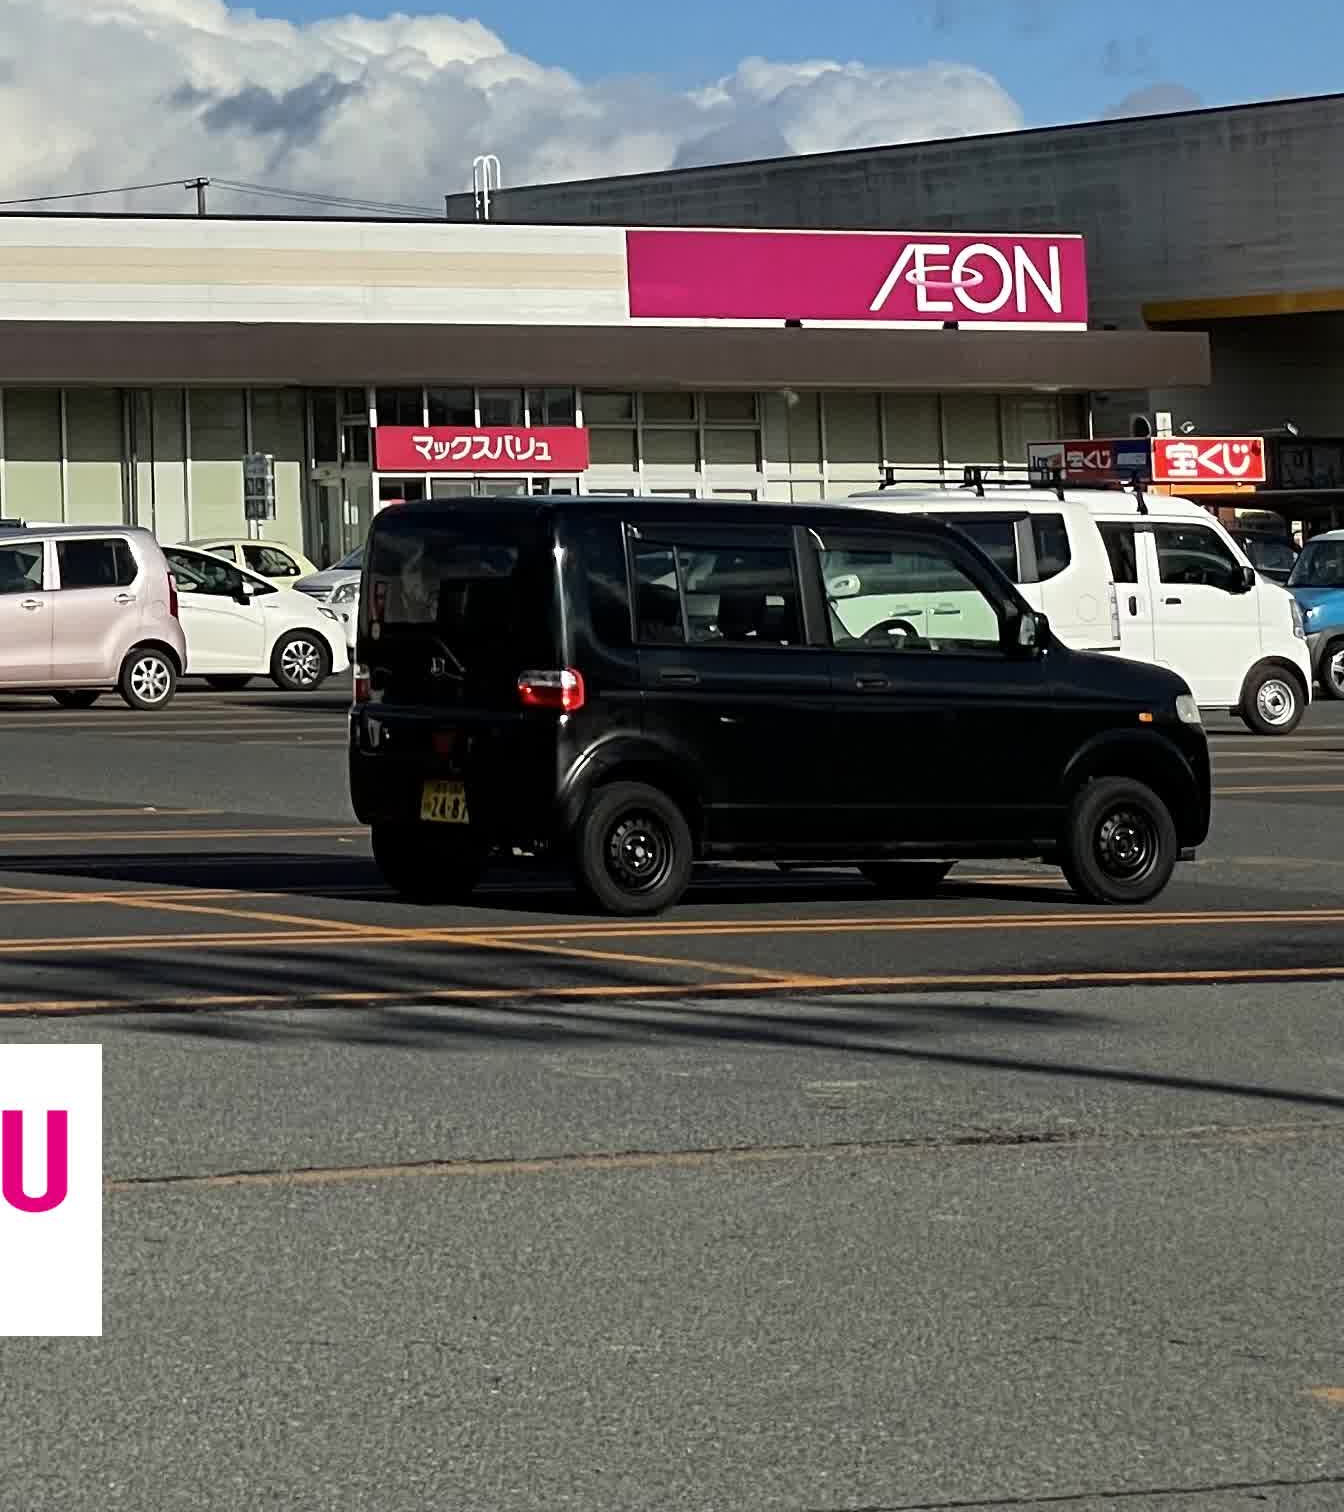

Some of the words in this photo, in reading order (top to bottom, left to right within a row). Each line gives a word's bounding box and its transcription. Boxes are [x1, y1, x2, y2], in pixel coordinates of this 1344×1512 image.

[412, 435, 552, 461] マックスバリュ
[1066, 449, 1112, 473] 宝くじ
[1165, 442, 1251, 477] 宝くじ
